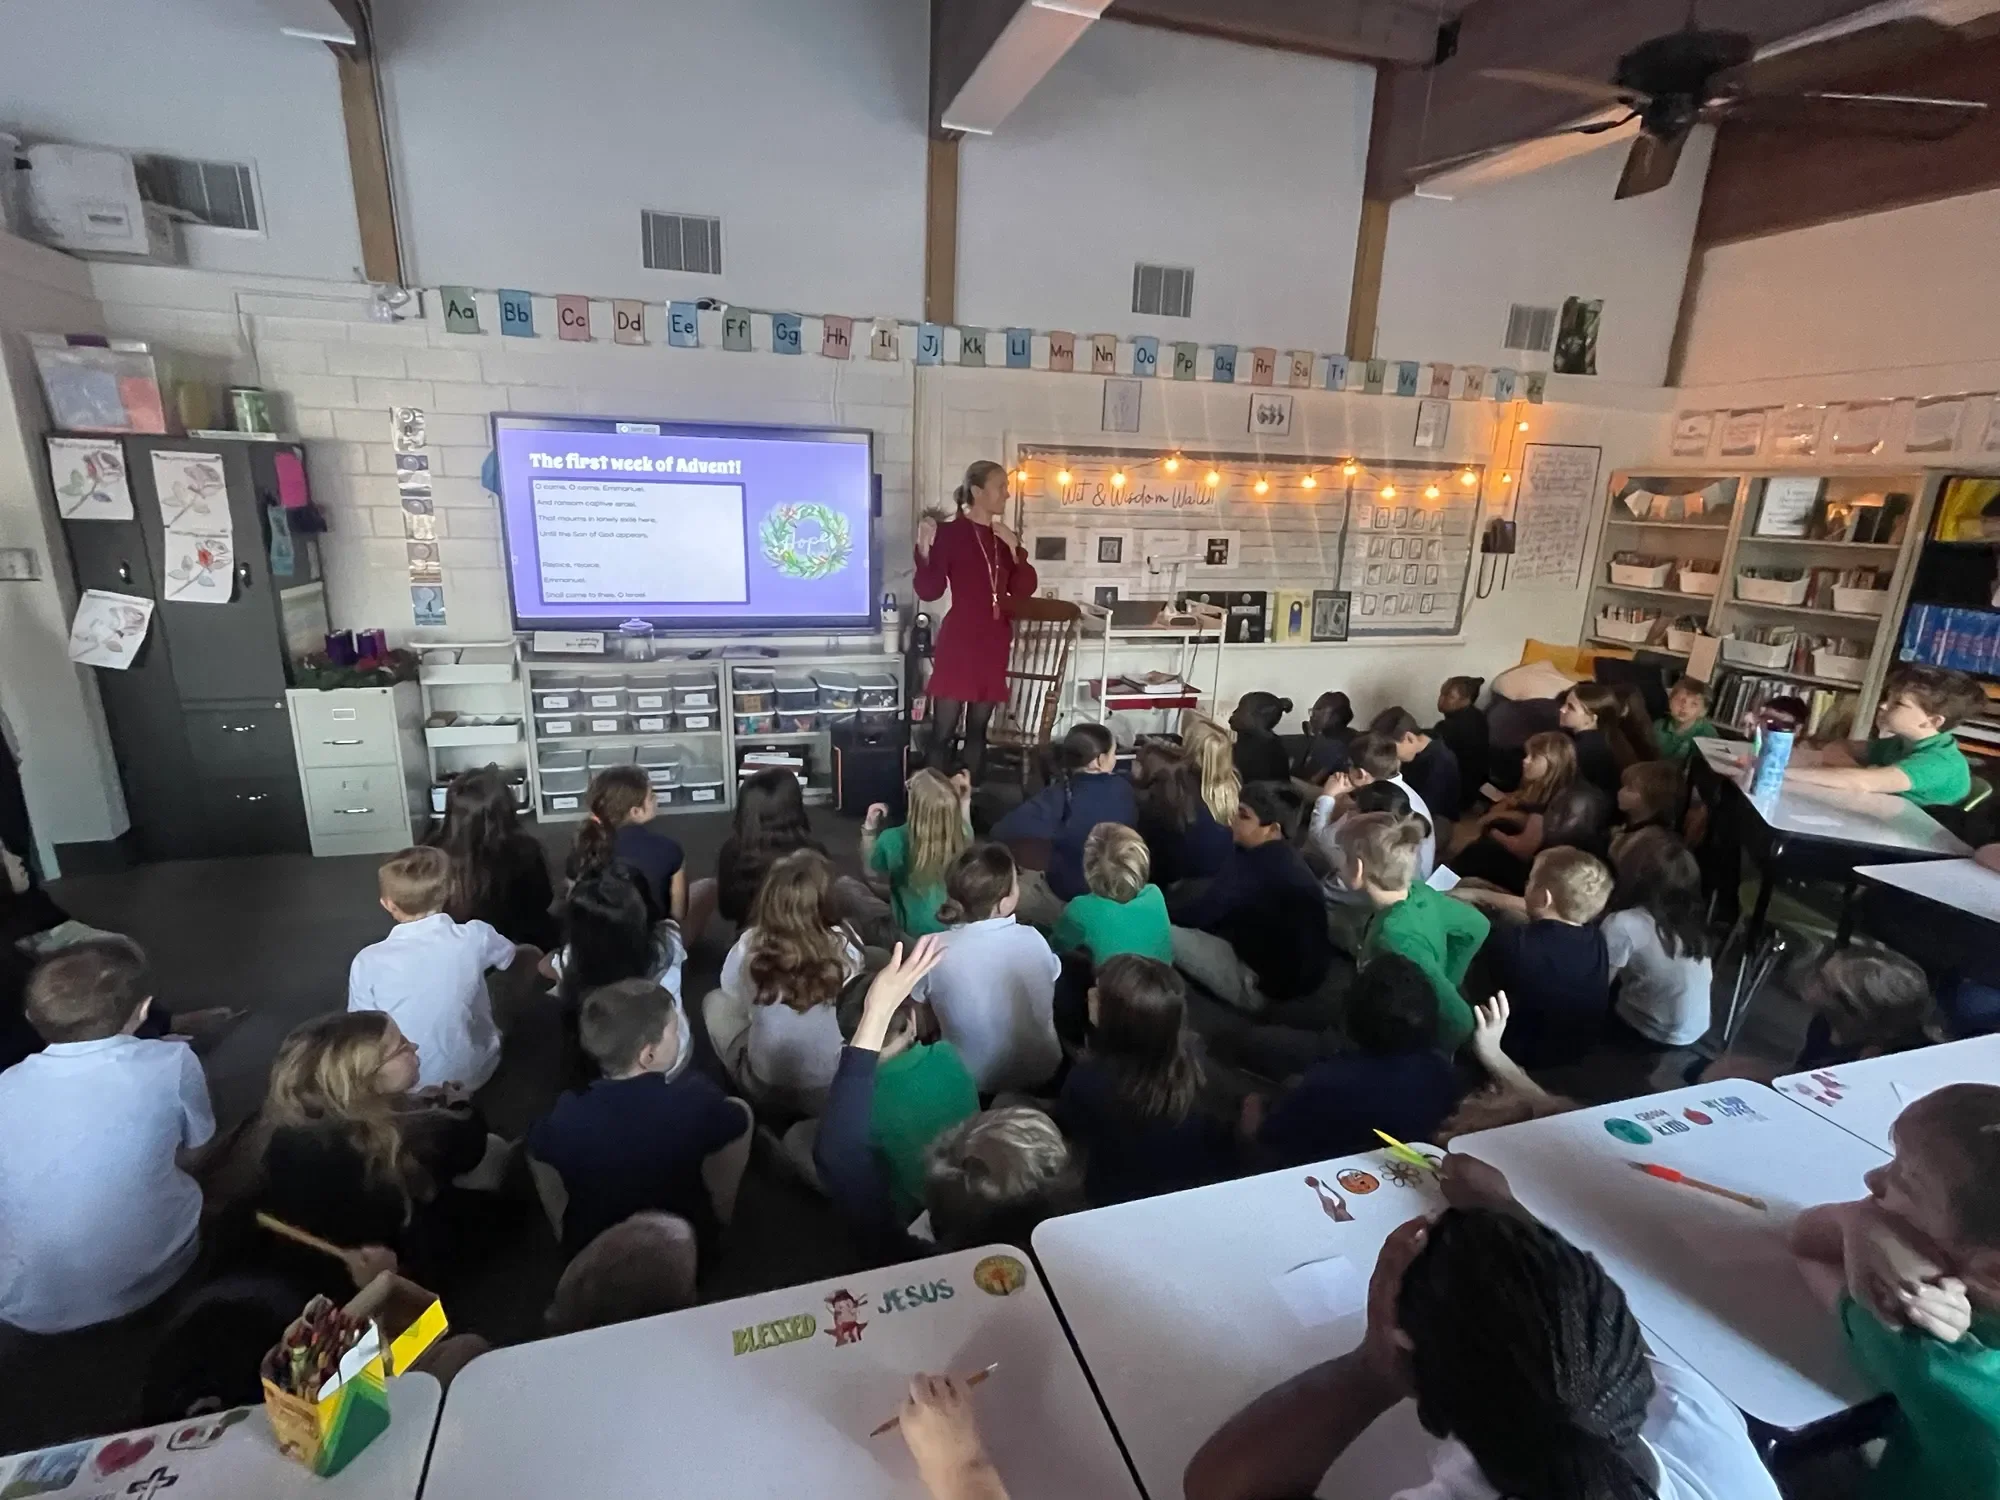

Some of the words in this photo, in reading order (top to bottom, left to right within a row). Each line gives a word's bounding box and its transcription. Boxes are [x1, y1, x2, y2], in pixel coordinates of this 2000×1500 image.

[447, 302, 474, 320] Aa
[504, 303, 529, 323] Bb
[561, 308, 586, 327] Cc
[617, 312, 641, 332] Dd
[673, 314, 694, 335] Ee
[726, 319, 748, 338] Ff
[776, 323, 798, 346] Gg
[827, 326, 848, 346] Hh
[879, 330, 891, 347] Ii
[922, 335, 939, 357] Jj
[964, 337, 982, 355] Kk
[1012, 339, 1025, 356] Ll
[1050, 344, 1074, 359] Mm
[1095, 348, 1114, 362] Nn
[1136, 348, 1155, 364] Oo
[1176, 353, 1193, 370] Pp
[1215, 356, 1233, 373] Qq
[1255, 361, 1272, 374] Rr
[1294, 361, 1308, 377] Ss
[1331, 364, 1344, 380] Tt
[1368, 370, 1381, 384] Uu
[1401, 371, 1415, 386] Vv
[1467, 375, 1480, 390] Xx
[1500, 377, 1512, 393] Yy
[529, 453, 564, 469] The
[566, 453, 608, 470] first
[611, 455, 653, 472] week
[655, 456, 674, 473] of
[676, 458, 742, 475] Advent!
[1062, 479, 1092, 506] Wit
[1092, 482, 1106, 507] &
[1111, 484, 1168, 508] Wisdom
[877, 1278, 955, 1314] JESUS
